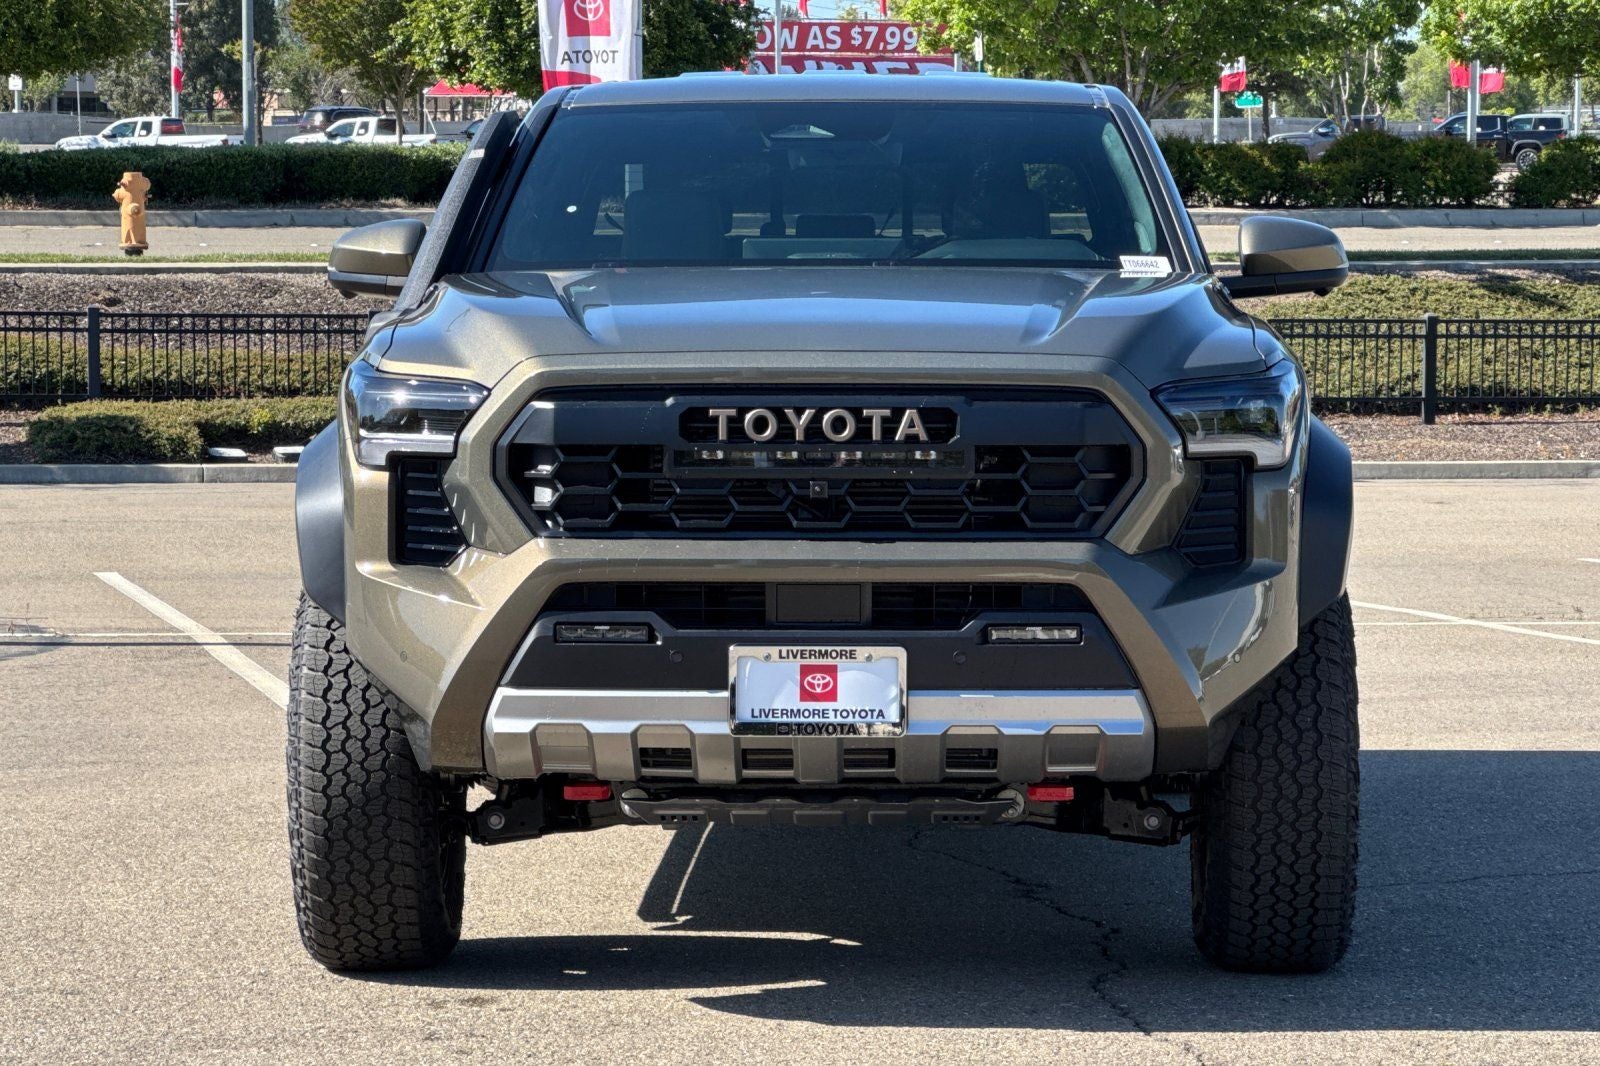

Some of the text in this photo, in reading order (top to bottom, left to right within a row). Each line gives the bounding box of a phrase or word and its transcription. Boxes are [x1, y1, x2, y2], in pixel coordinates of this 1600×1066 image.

[755, 25, 919, 51] OW AS $7,99
[708, 408, 930, 443] TOYOTA
[778, 649, 857, 660] LIVERMORE
[751, 708, 886, 719] LIVERMORE TOYOTA
[795, 723, 858, 736] TOYOTA
